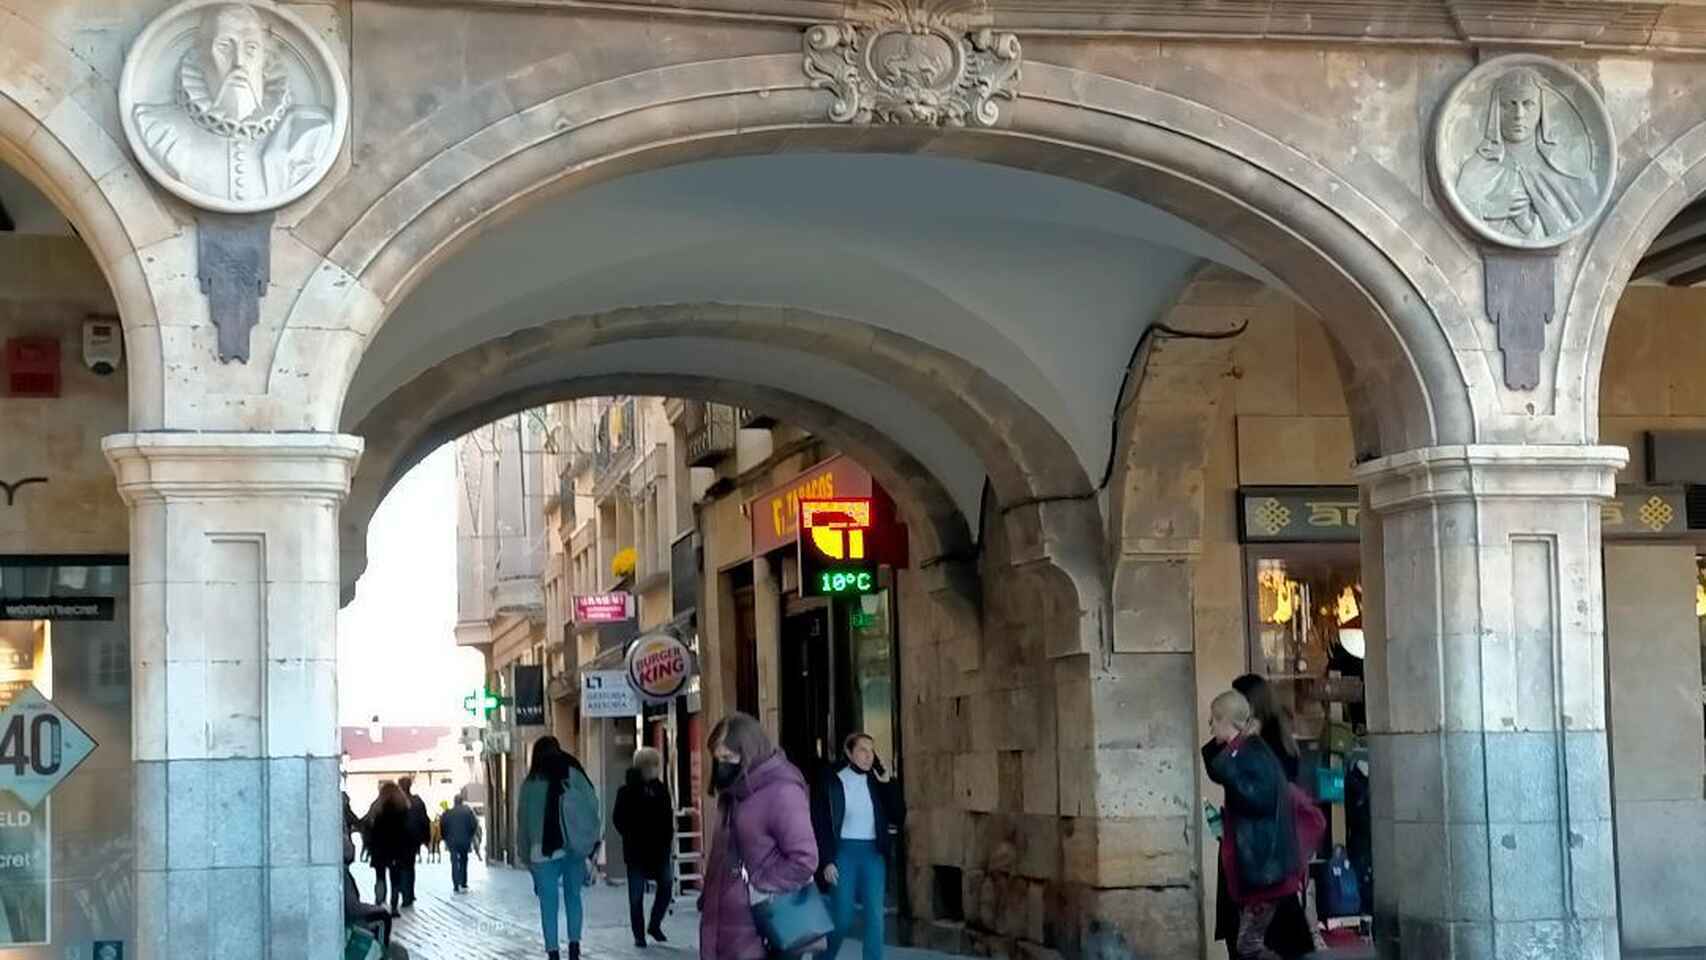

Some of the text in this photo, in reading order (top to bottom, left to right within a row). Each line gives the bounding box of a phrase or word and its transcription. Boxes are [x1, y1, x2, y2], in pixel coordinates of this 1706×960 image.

[822, 572, 871, 592] 10°C
[637, 647, 680, 672] BURGER
[641, 658, 684, 685] KING
